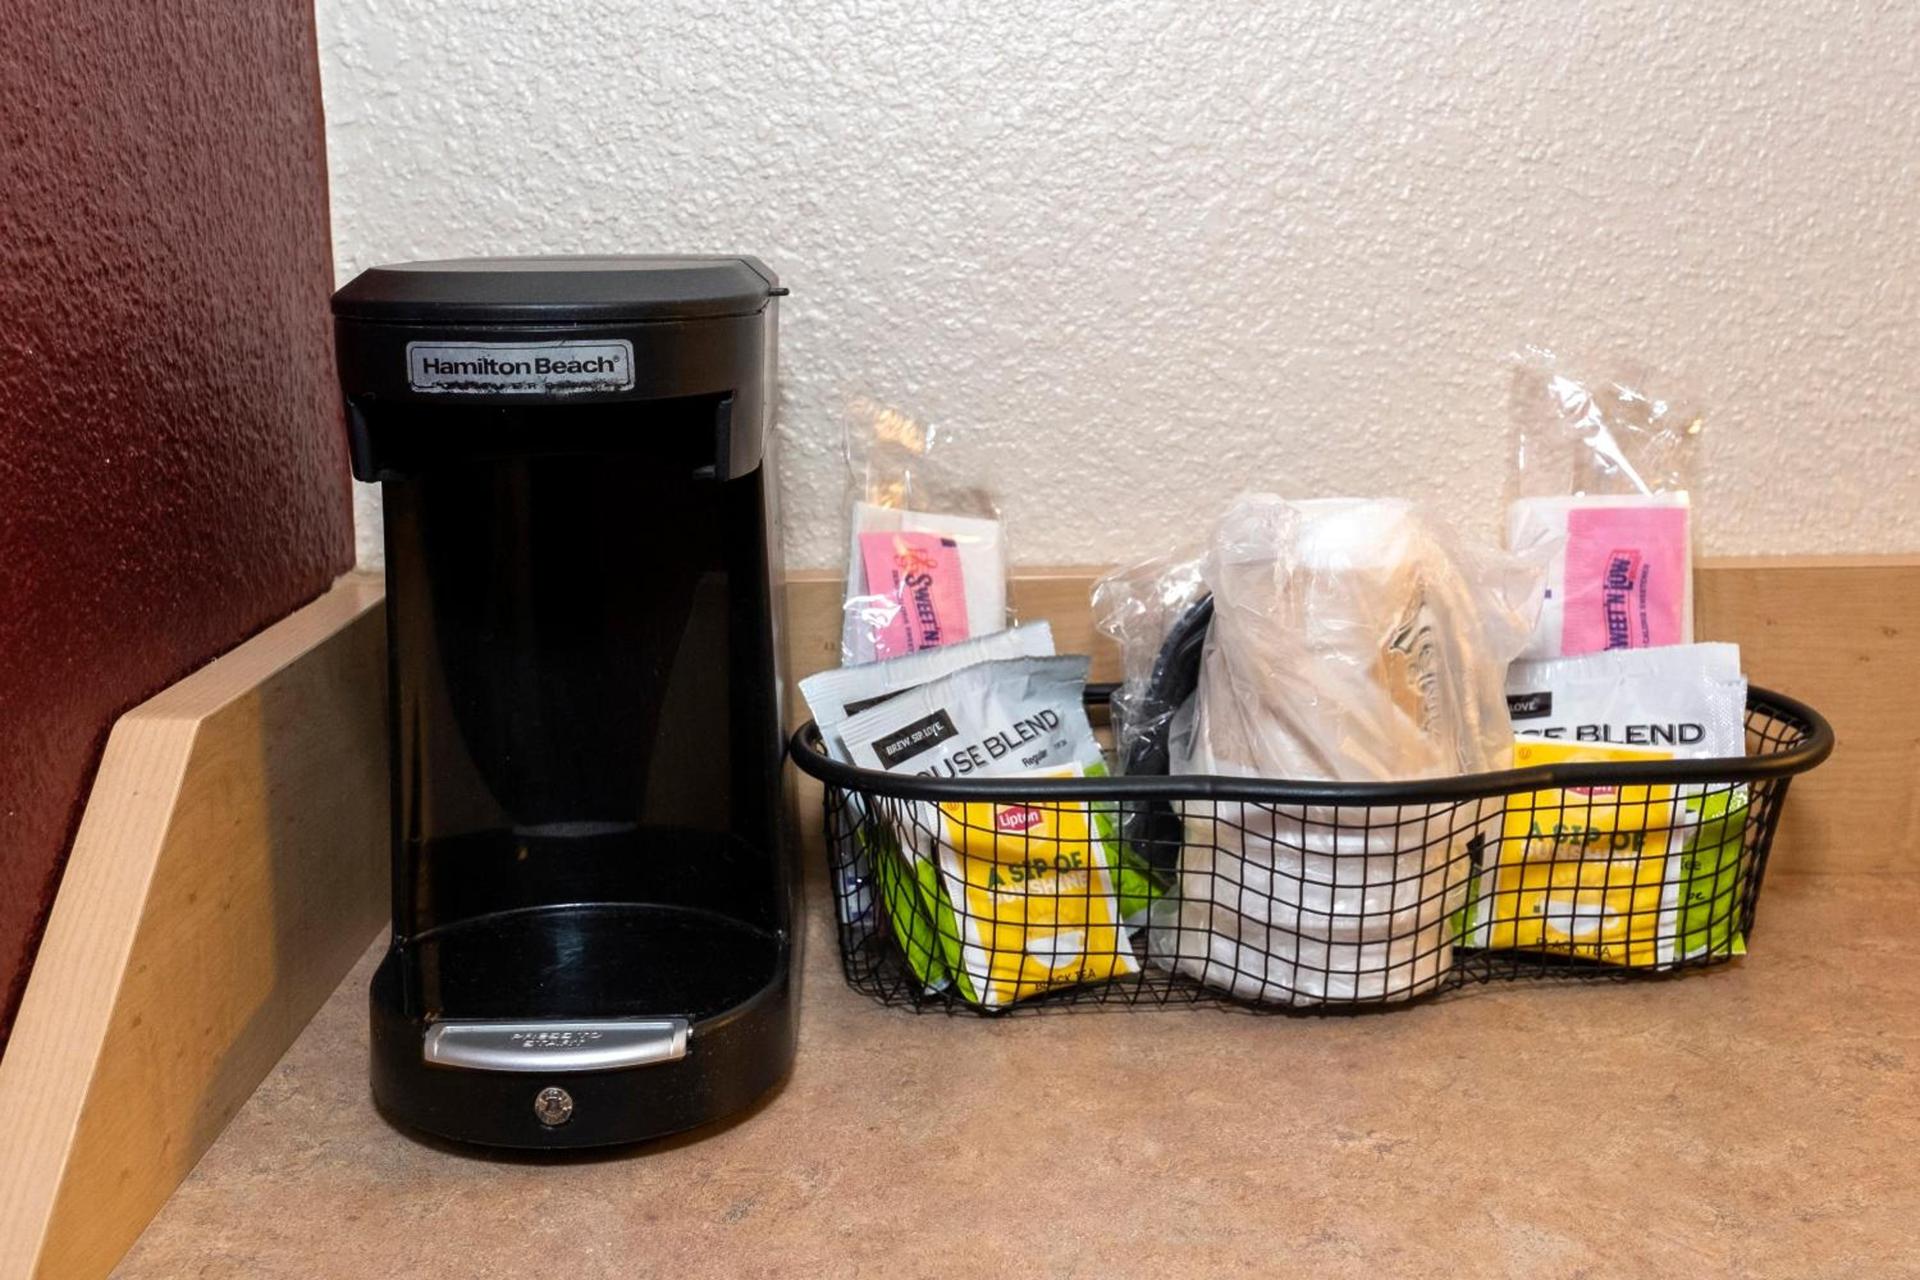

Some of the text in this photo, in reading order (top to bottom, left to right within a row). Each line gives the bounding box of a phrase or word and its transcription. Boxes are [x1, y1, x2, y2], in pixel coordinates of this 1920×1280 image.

[423, 356, 615, 376] Hamilton Beach
[1603, 592, 1630, 651] WEET'N
[983, 709, 1060, 759] BLEND
[1576, 722, 1706, 747] BLEND
[999, 810, 1040, 829] Lipton
[988, 850, 1084, 888] A SIP OF
